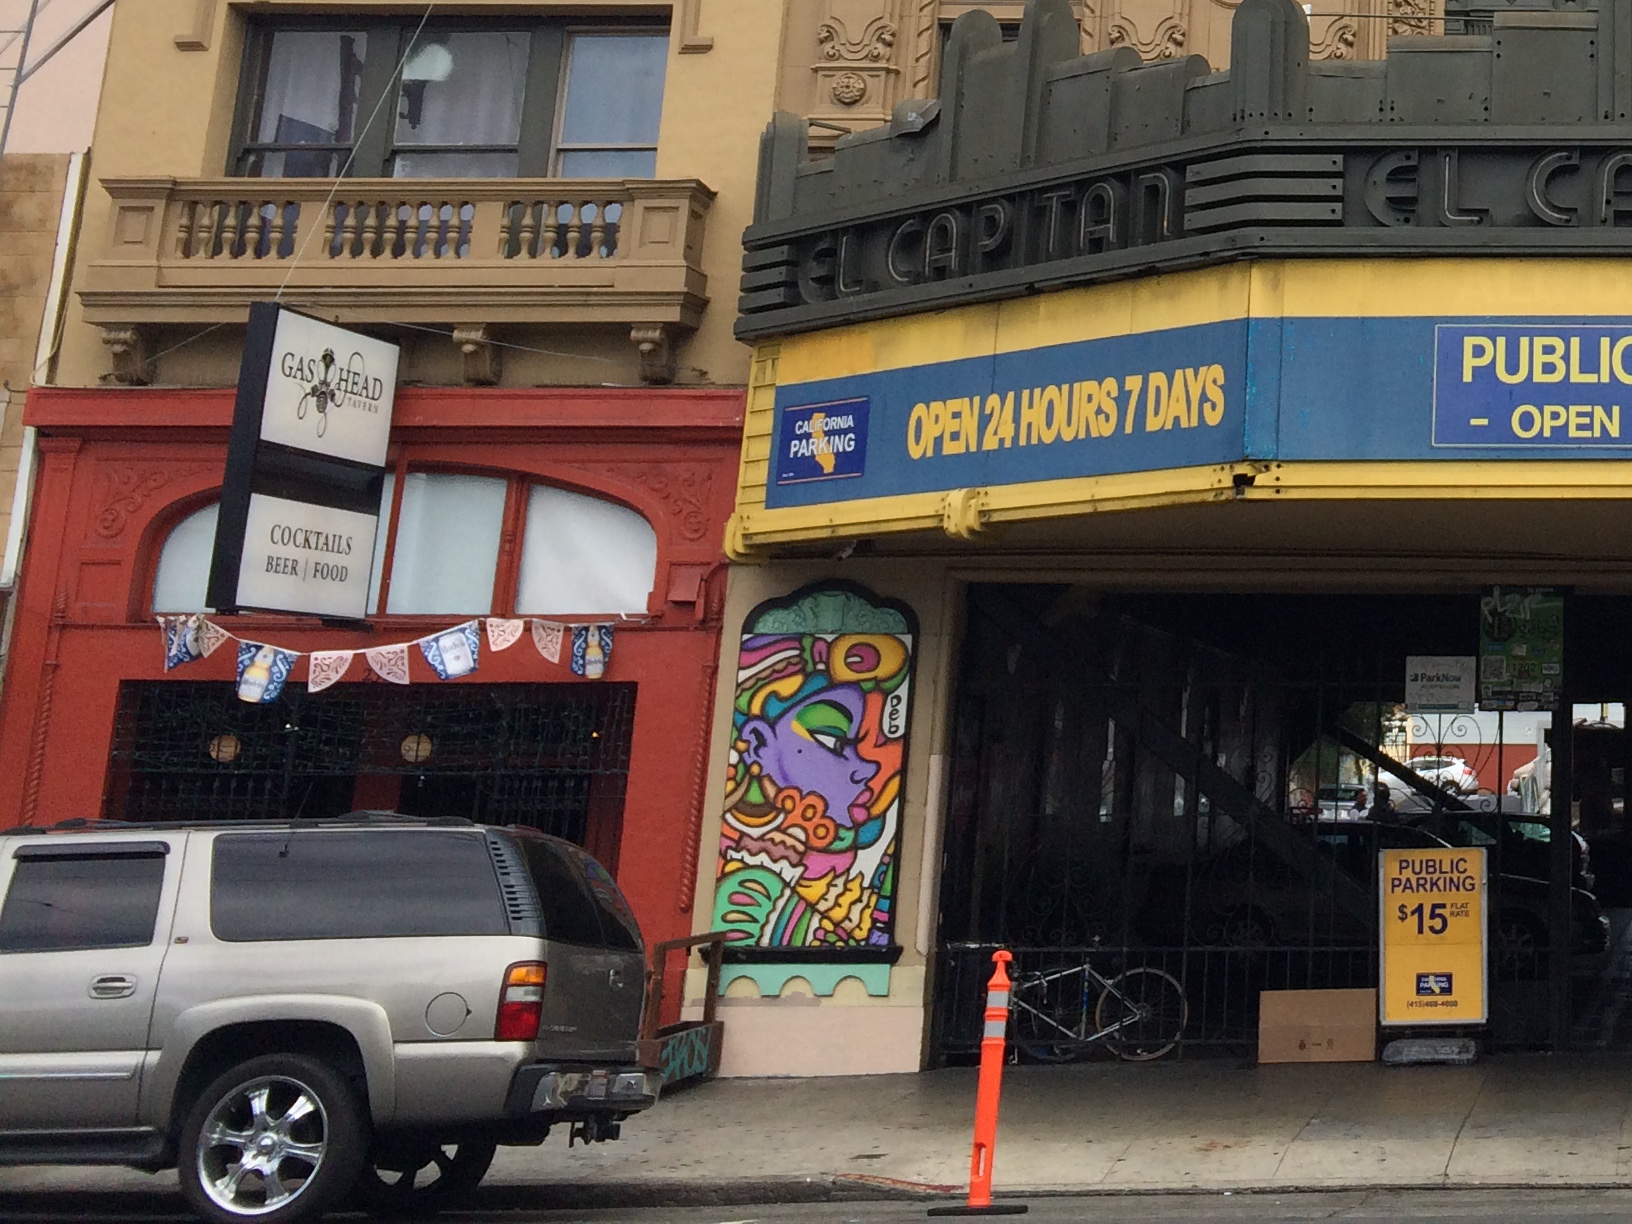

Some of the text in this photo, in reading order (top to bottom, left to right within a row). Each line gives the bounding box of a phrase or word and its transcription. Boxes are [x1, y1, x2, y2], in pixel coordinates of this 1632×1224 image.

[1364, 148, 1489, 229] EL
[798, 166, 1184, 304] EL CAPITAN
[281, 351, 384, 402] GAS HEAD
[347, 397, 379, 414] TAVERN
[907, 363, 1225, 460] OPEN 24 HOURS 7 DAYS
[1511, 404, 1621, 440] OPEN
[795, 414, 855, 435] CALIFORNIA
[789, 432, 856, 458] PARKING
[270, 523, 353, 556] COCKTAILS
[265, 555, 349, 583] BEER FOOD
[1398, 857, 1468, 876] PUBLIC
[1390, 876, 1476, 894] PARKING
[1397, 902, 1449, 935] $15
